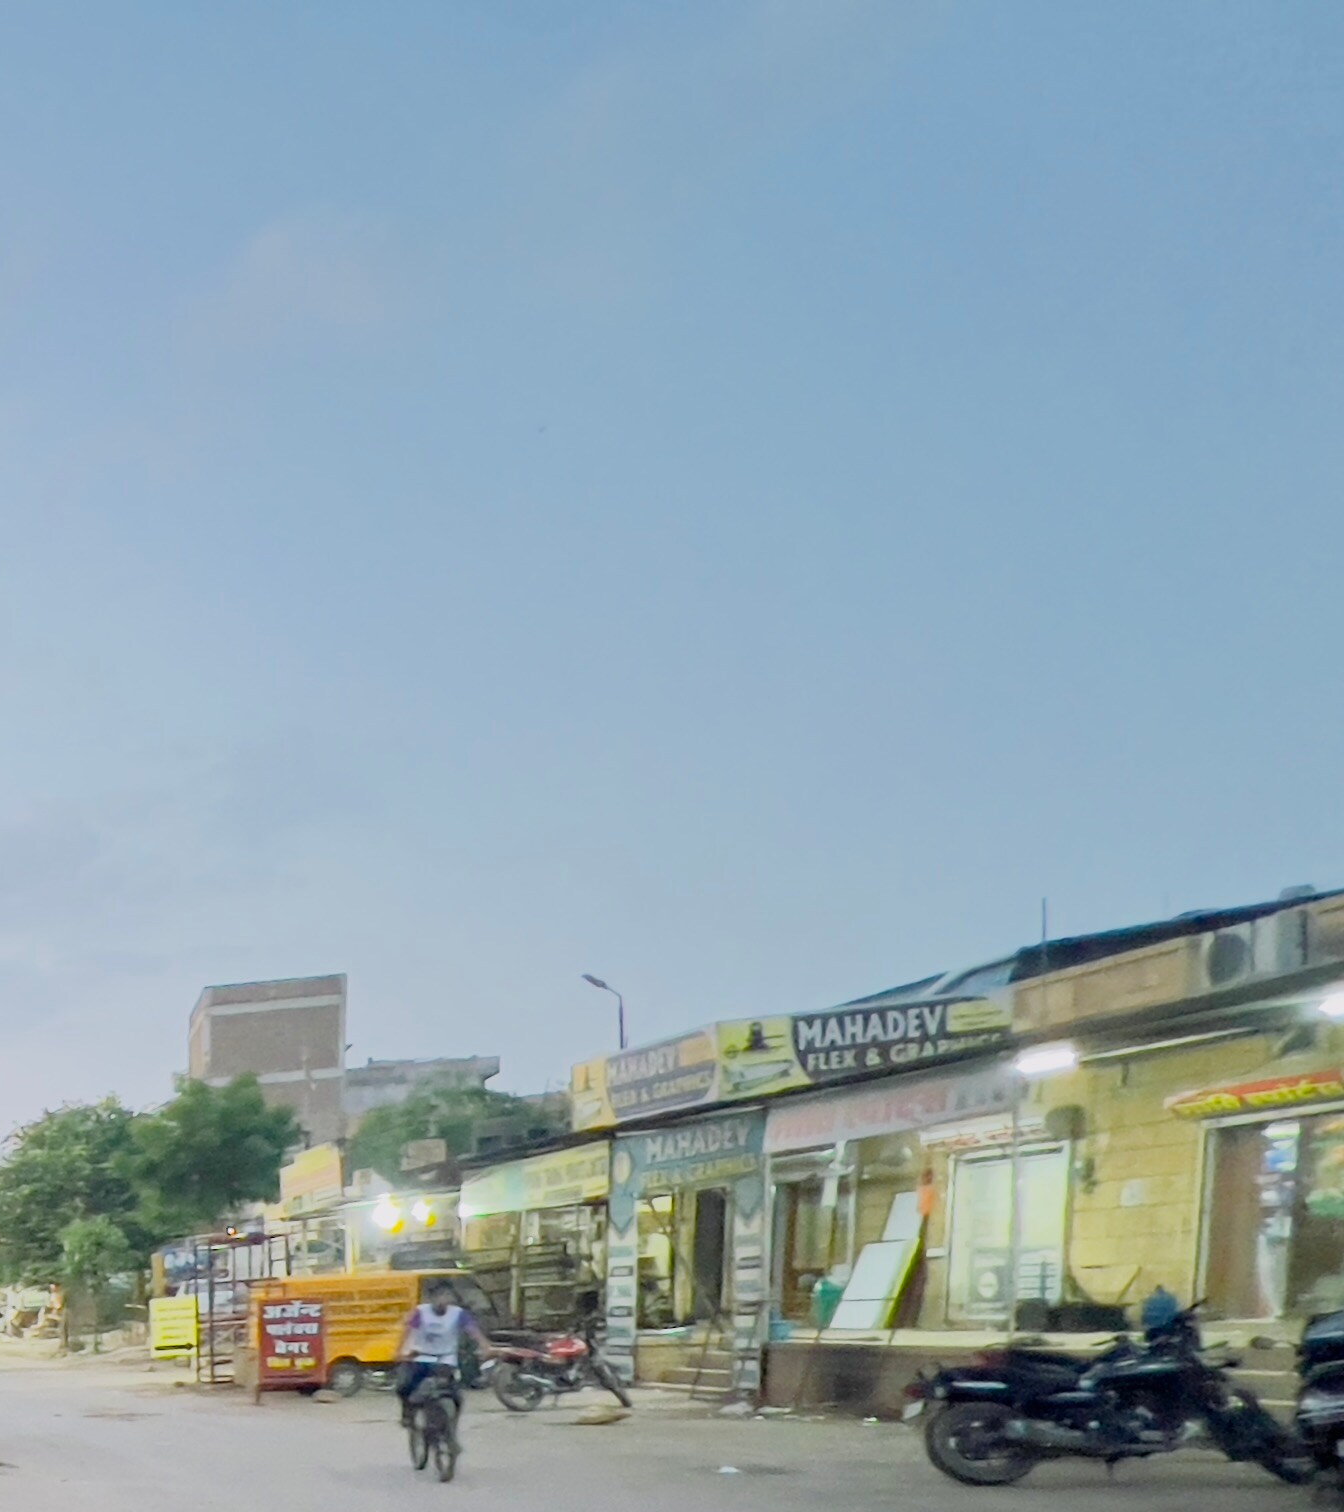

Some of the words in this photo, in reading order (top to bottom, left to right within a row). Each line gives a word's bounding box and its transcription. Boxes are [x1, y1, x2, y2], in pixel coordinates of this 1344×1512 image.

[797, 1004, 946, 1051] MAHADEV
[606, 1044, 678, 1086] MAHADEV
[806, 1049, 857, 1072] FLEX
[864, 1046, 882, 1067] &
[644, 1118, 751, 1165] MAHADEV
